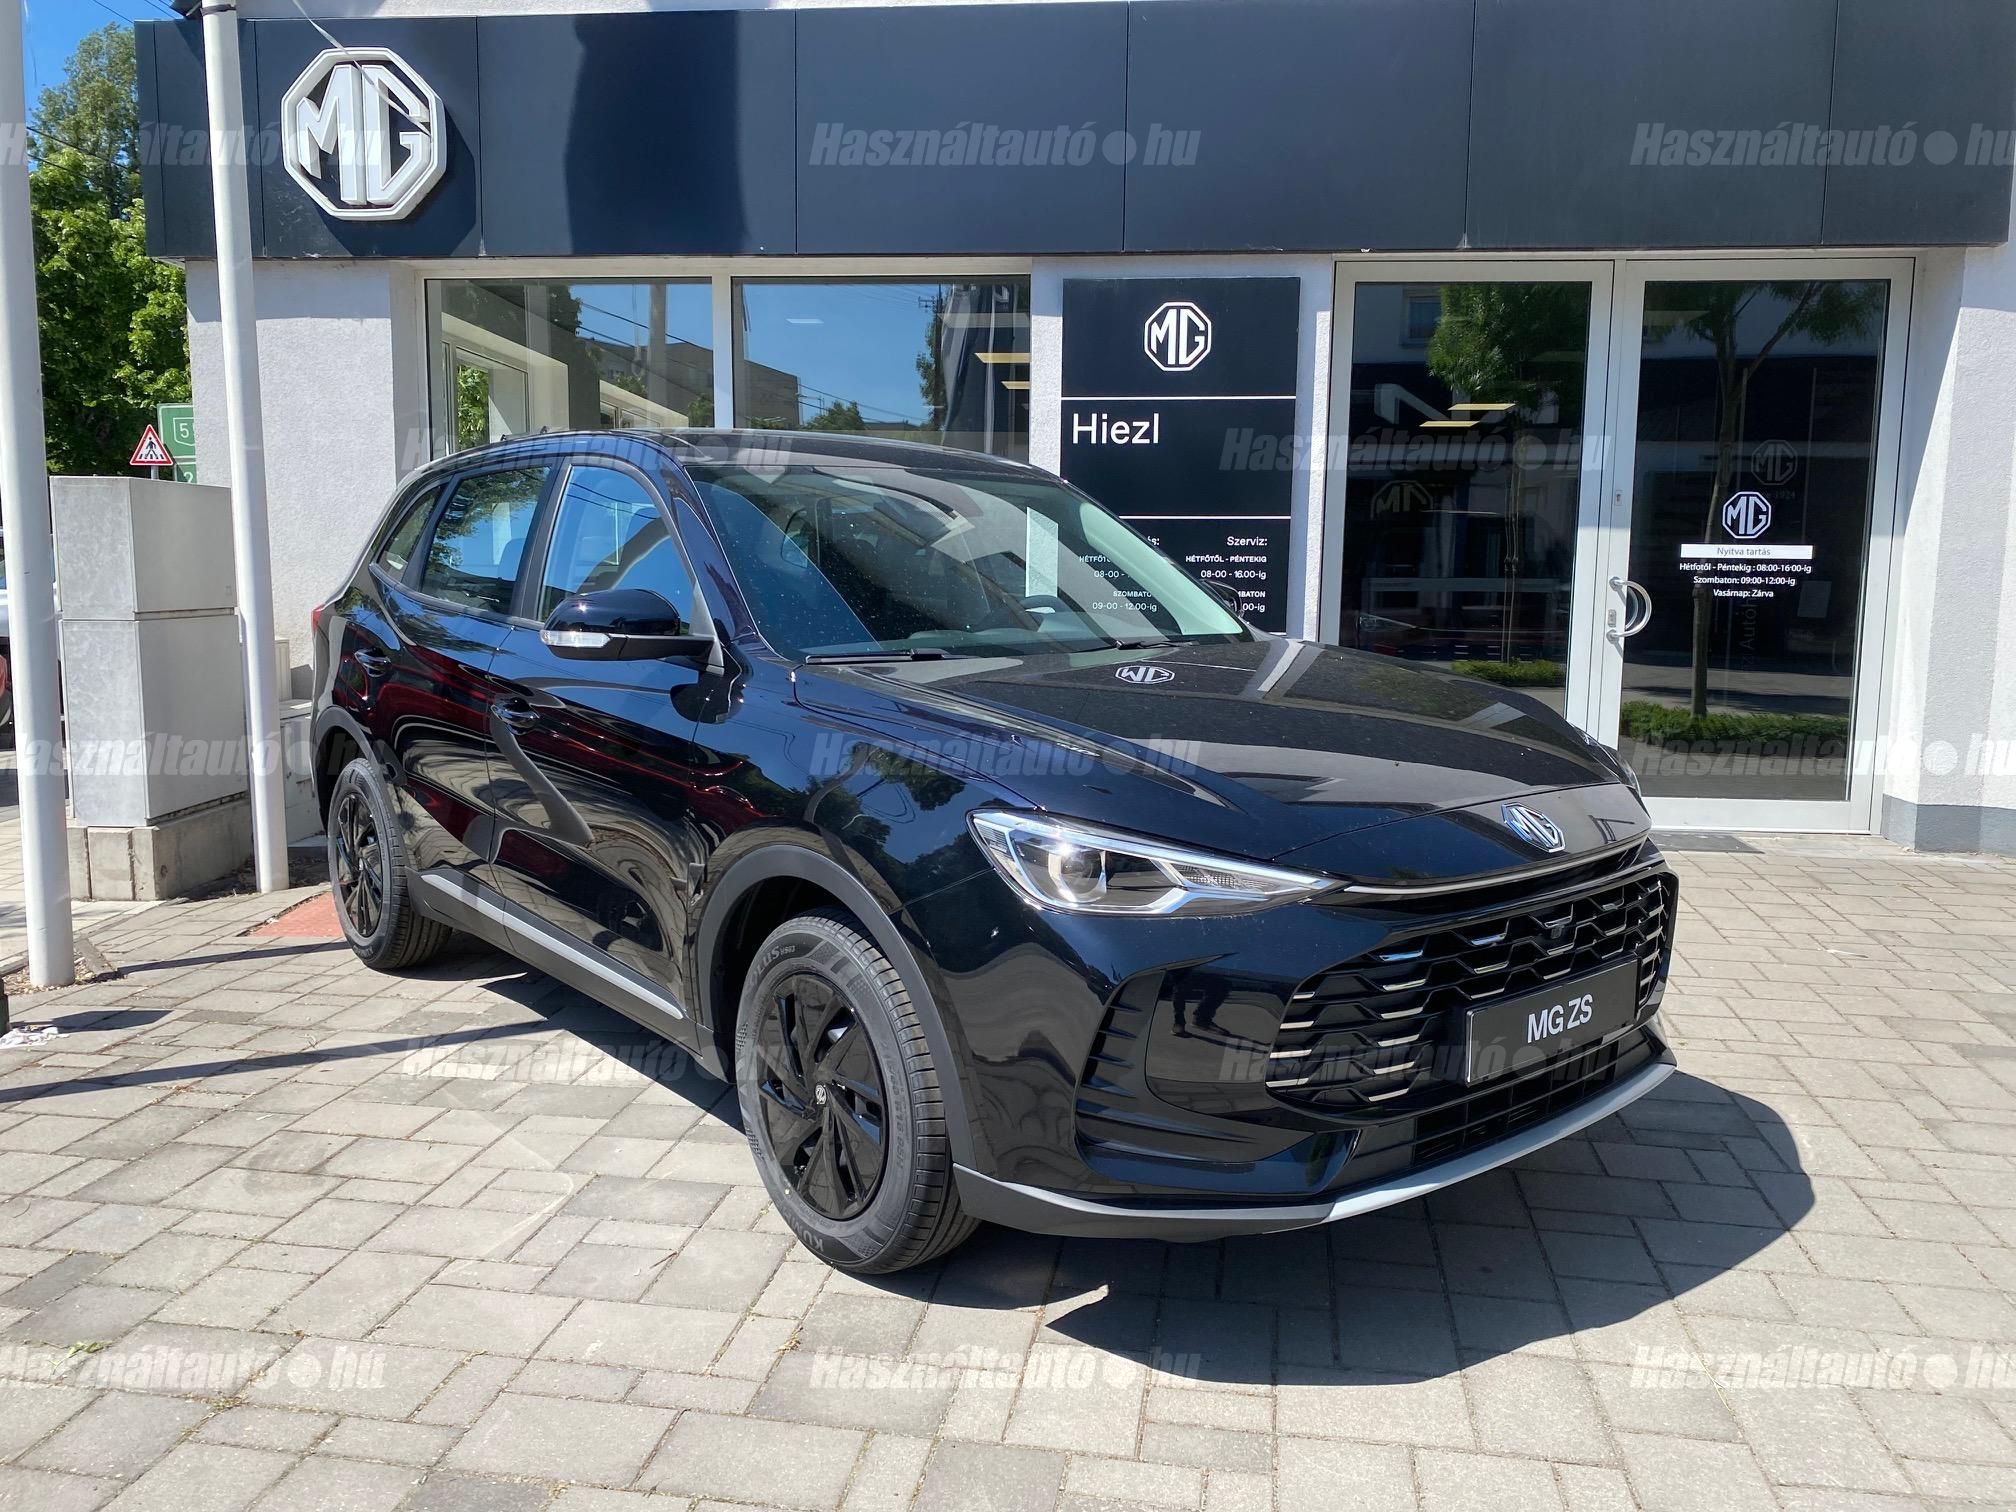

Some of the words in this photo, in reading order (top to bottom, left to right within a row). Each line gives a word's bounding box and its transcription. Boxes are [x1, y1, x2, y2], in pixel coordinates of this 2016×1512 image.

[297, 63, 432, 206] MG
[1150, 308, 1206, 365] MG
[1072, 412, 1160, 445] Hiezl
[1726, 496, 1768, 535] MG
[1226, 536, 1268, 546] Szerviz:
[1717, 547, 1744, 557] Nyitva
[1746, 547, 1771, 556] tartás
[1229, 554, 1267, 563] PÉNTEKIG
[1200, 570, 1227, 578] 08-00
[1693, 576, 1740, 585] Szombaton:
[1112, 590, 1152, 598] SZOMBATO
[1751, 588, 1774, 598] Zárva
[1510, 805, 1559, 849] MG
[1526, 1009, 1564, 1044] MG
[1567, 993, 1594, 1030] ZS
